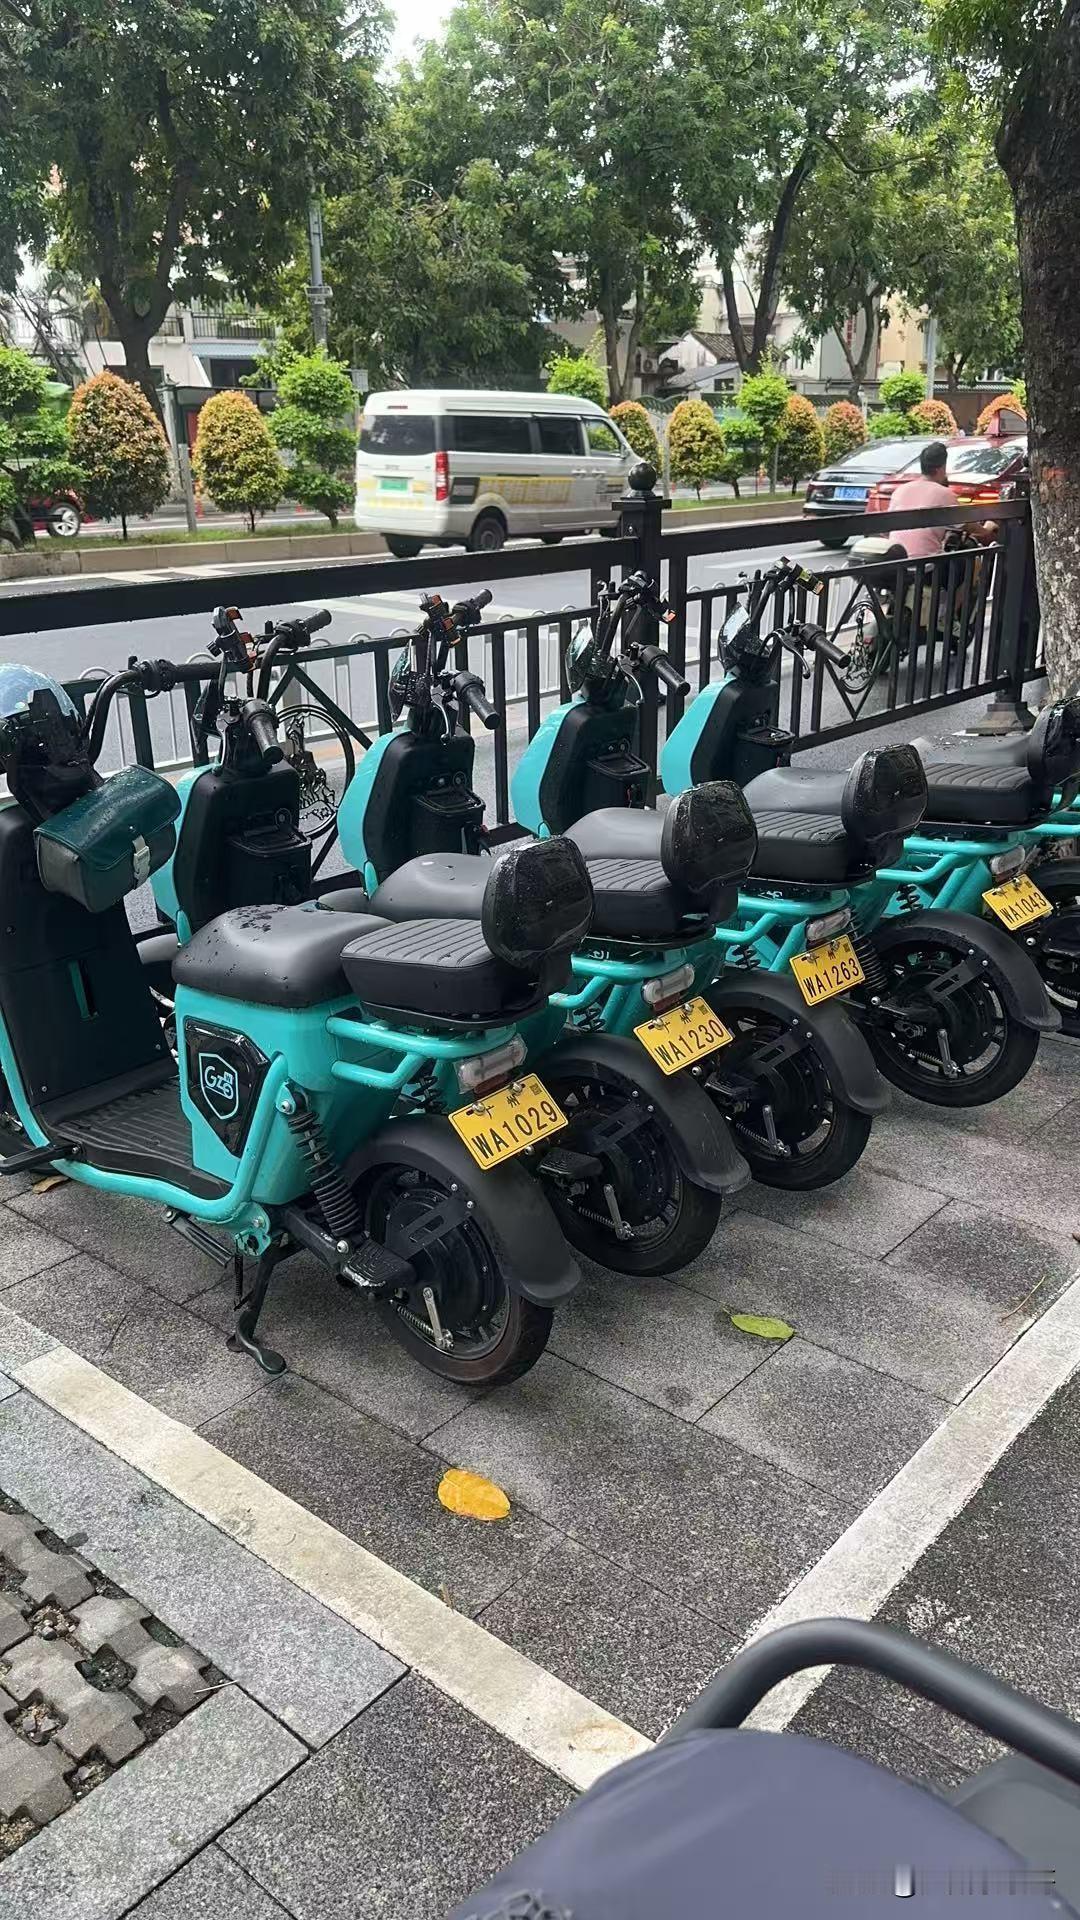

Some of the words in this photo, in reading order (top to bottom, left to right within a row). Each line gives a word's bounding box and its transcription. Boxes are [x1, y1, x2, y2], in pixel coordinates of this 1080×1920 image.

[1000, 892, 1047, 924] WA1043
[803, 958, 859, 997] WA1263
[654, 1019, 724, 1066] WA1230
[471, 1101, 558, 1159] WA1029
